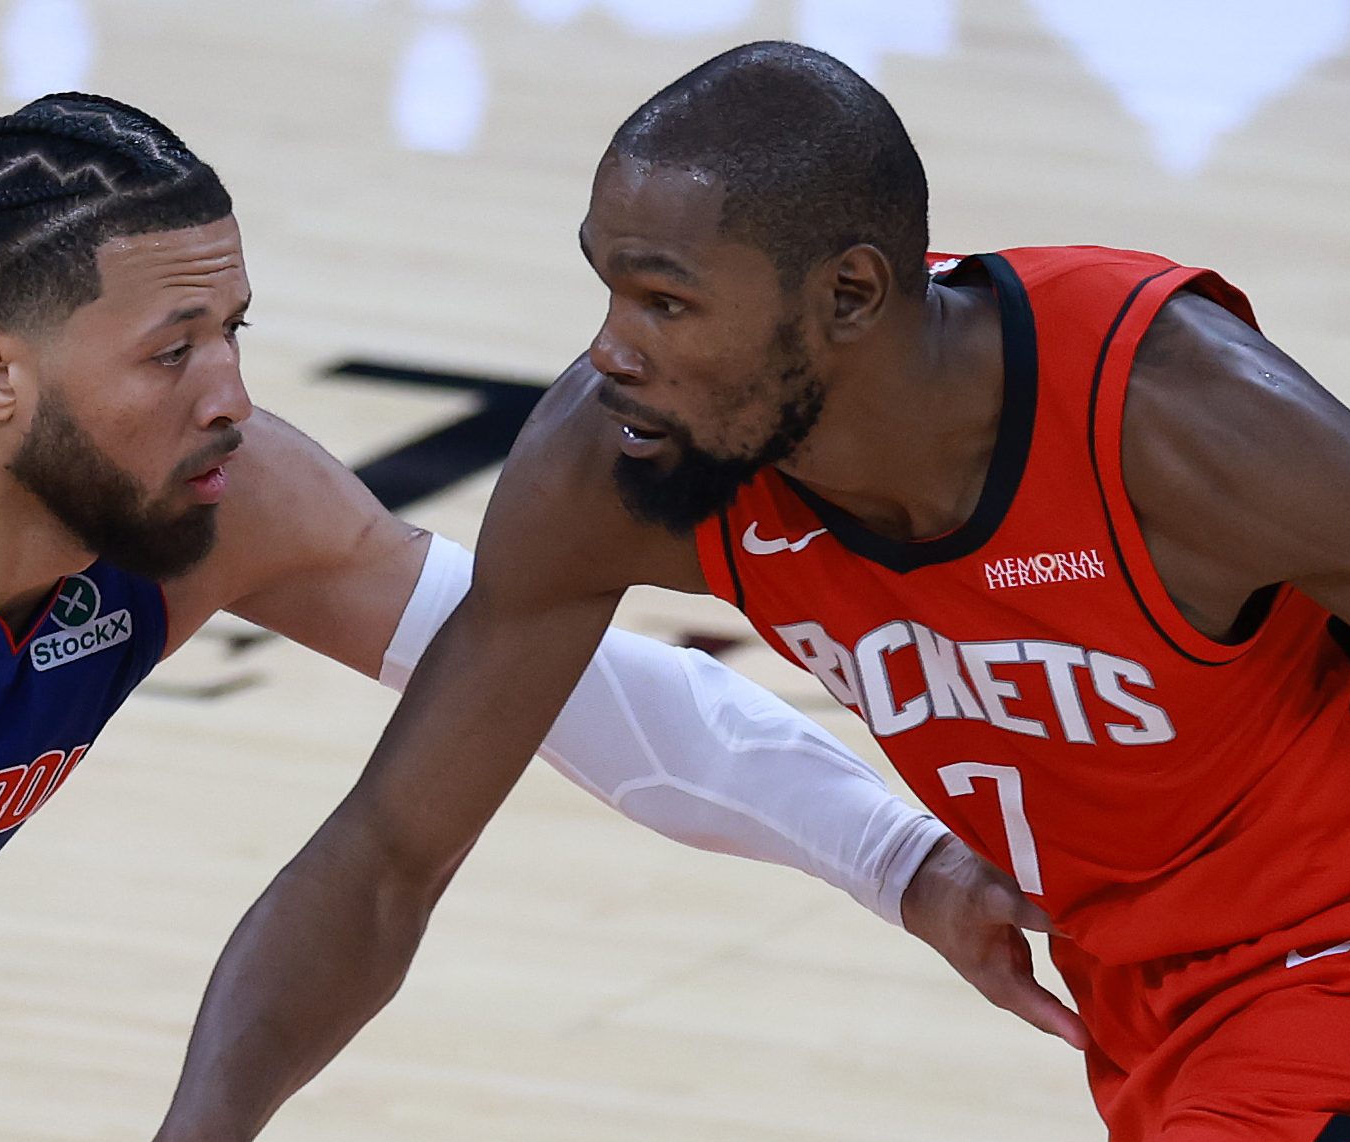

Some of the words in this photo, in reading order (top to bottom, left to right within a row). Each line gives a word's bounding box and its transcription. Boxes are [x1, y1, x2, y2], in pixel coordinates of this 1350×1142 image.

[984, 549, 1104, 576] MEMORIAL
[986, 562, 1106, 589] HERMANN
[34, 612, 129, 665] StockX
[937, 761, 1044, 896] 7
